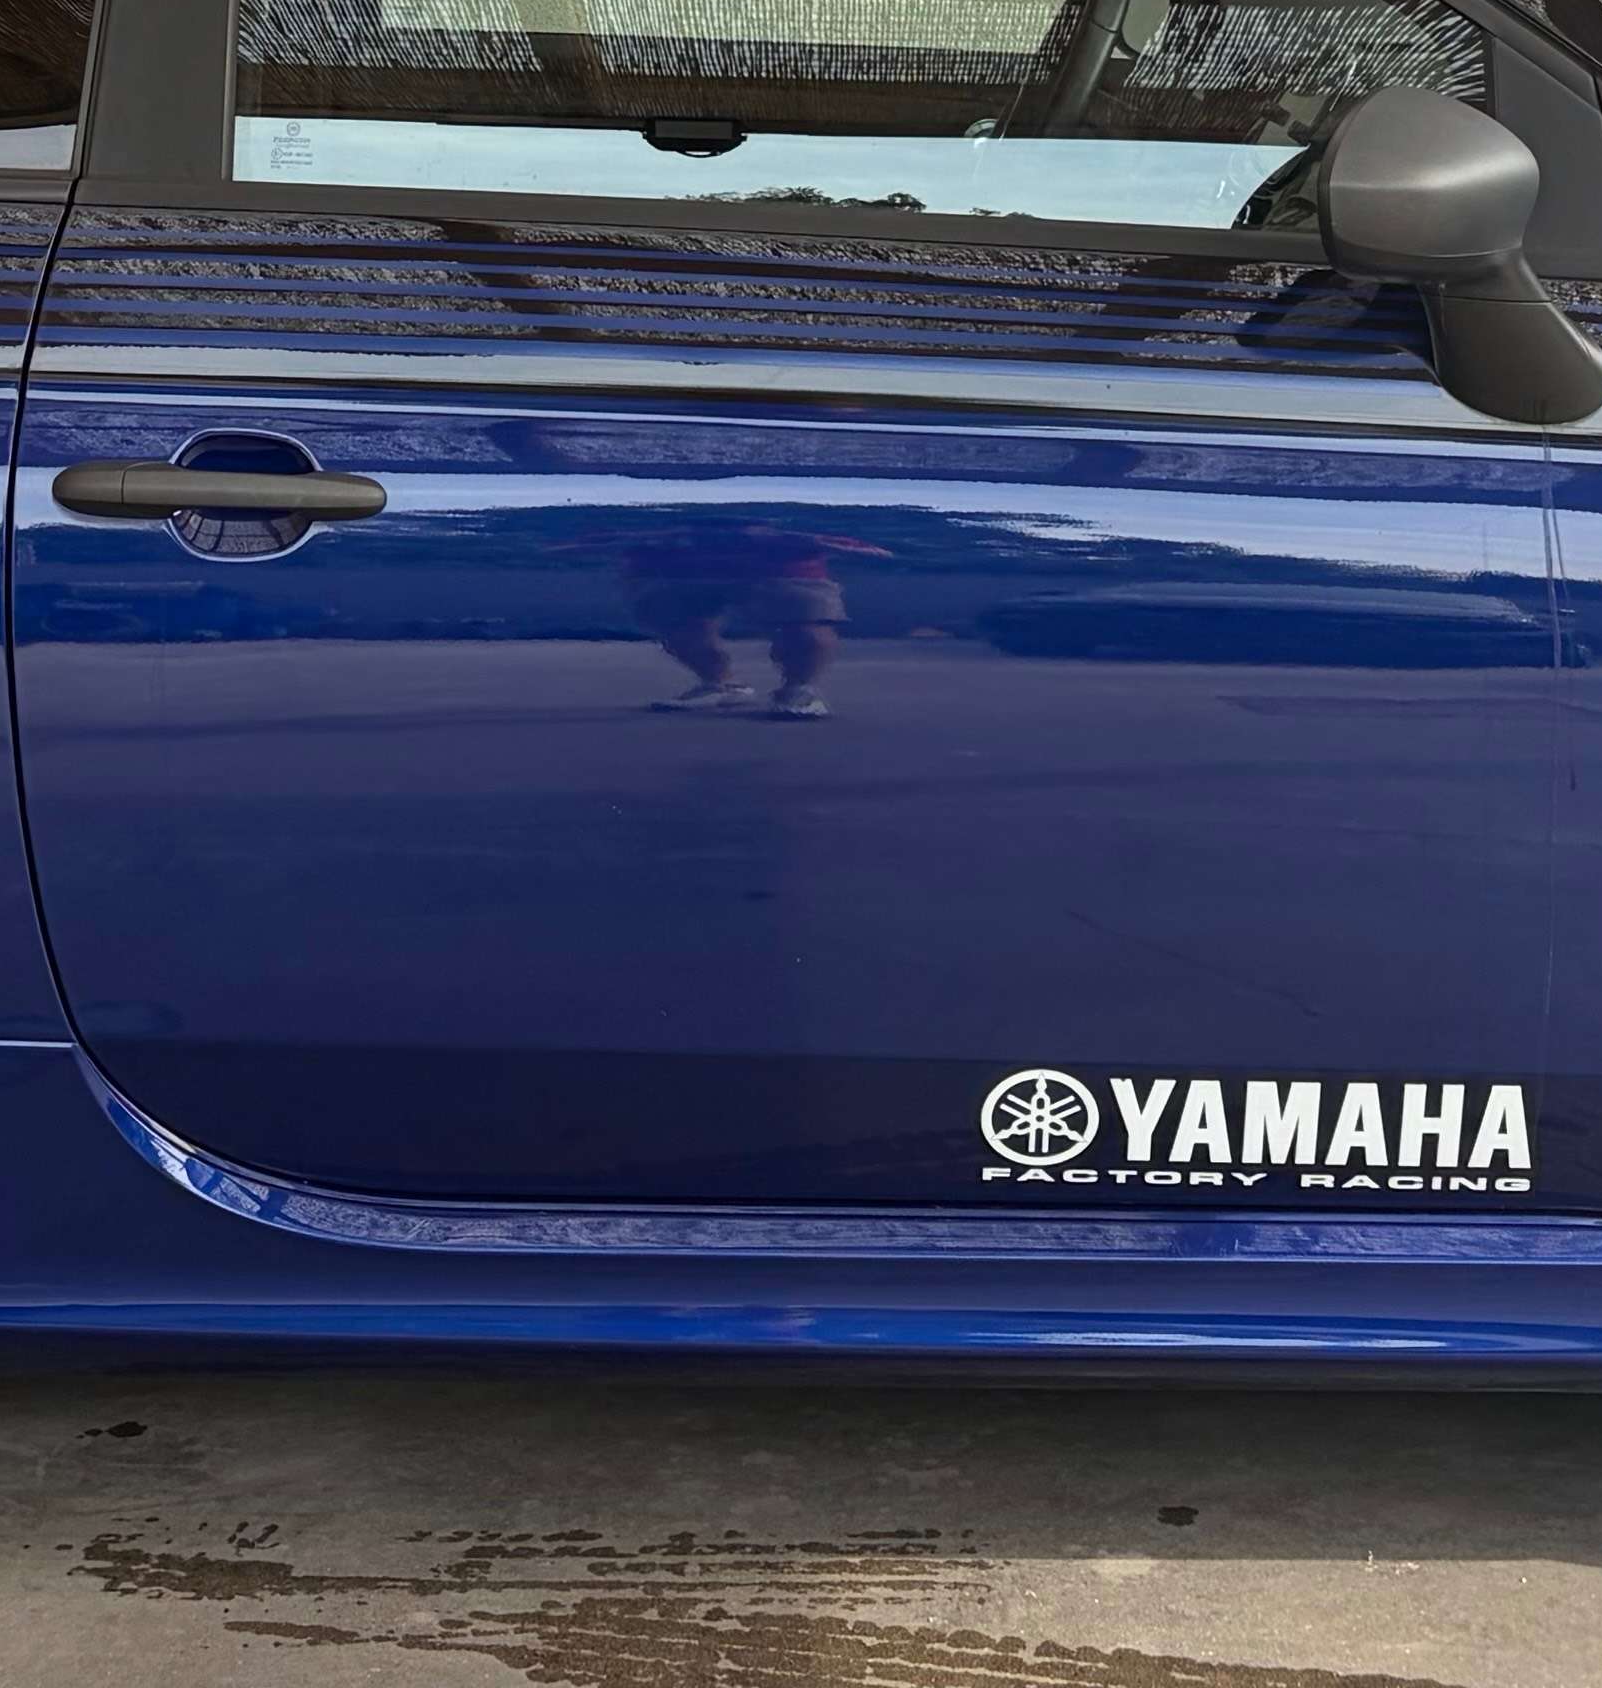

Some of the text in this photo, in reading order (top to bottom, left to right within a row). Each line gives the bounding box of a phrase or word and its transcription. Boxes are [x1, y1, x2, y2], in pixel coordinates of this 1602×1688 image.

[1109, 1078, 1532, 1169] YAMAHA
[982, 1167, 1532, 1192] FACTORY RACING
